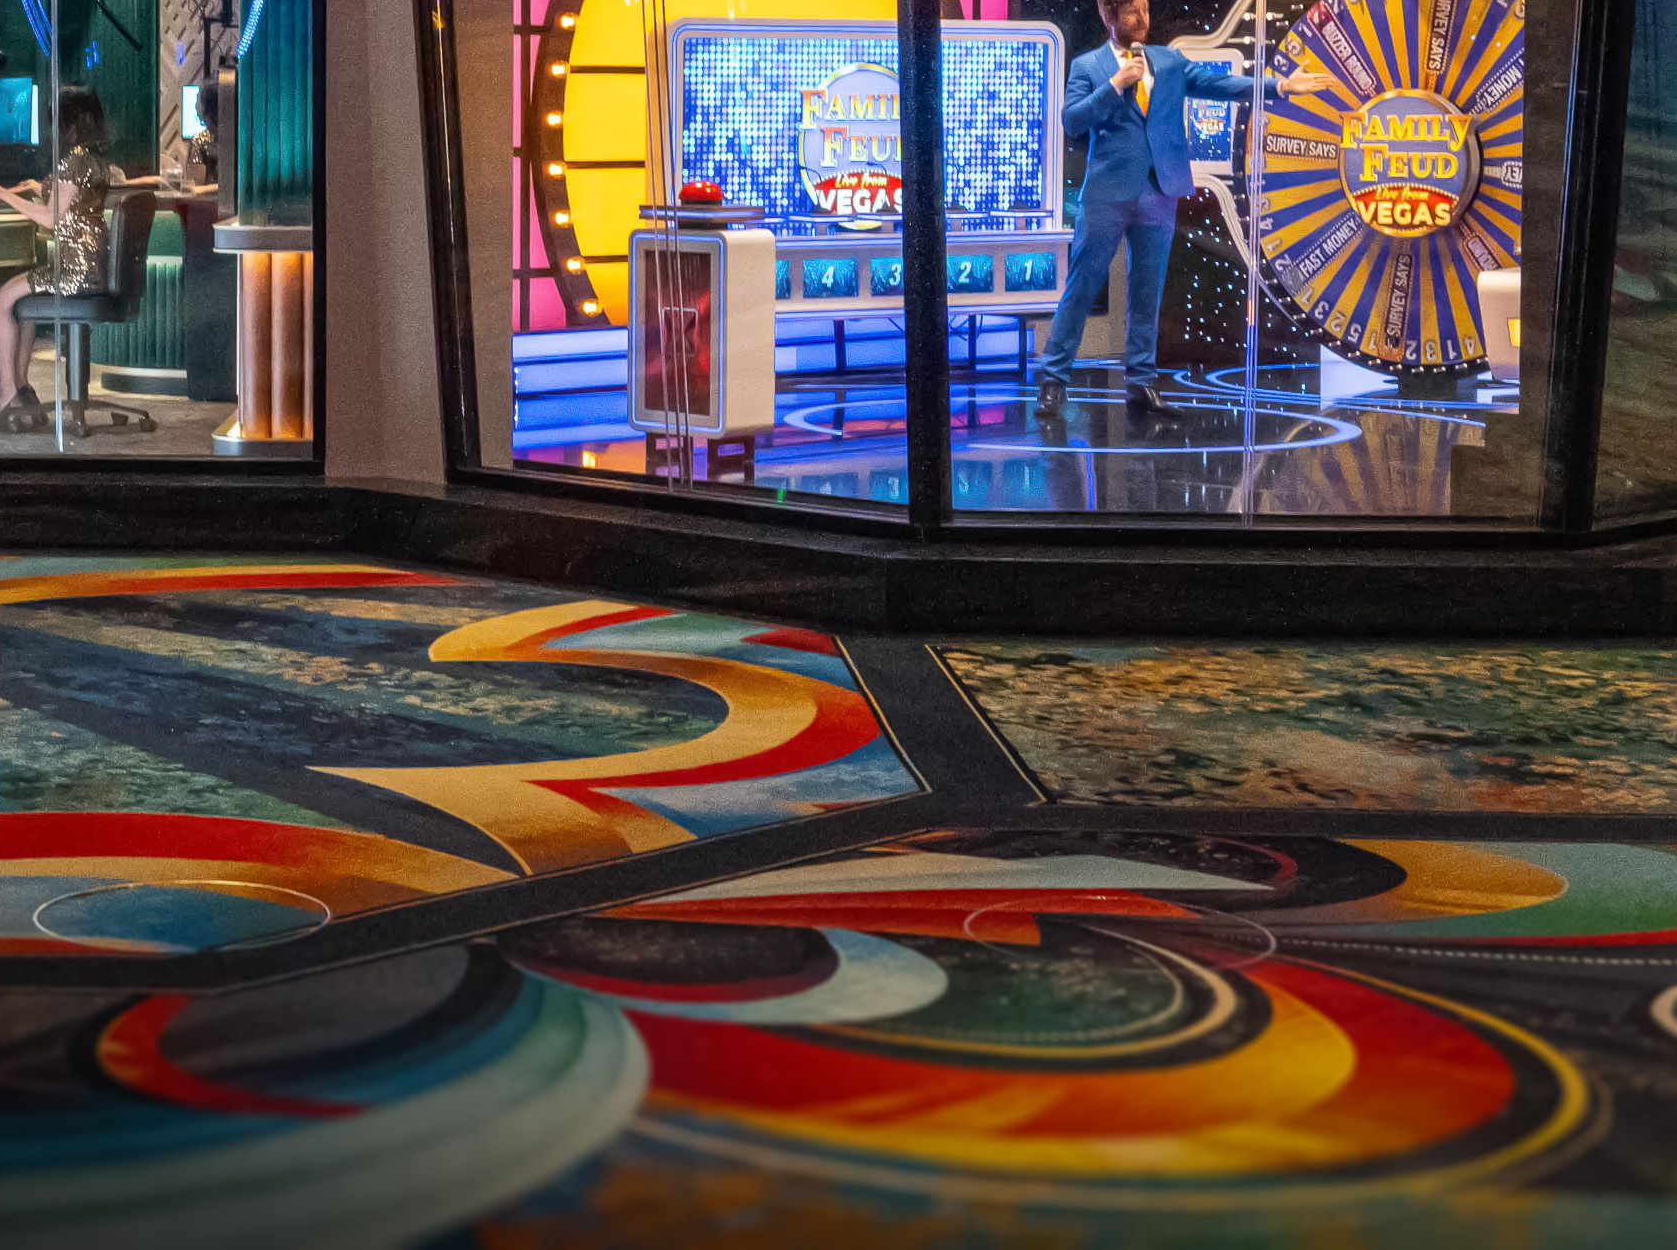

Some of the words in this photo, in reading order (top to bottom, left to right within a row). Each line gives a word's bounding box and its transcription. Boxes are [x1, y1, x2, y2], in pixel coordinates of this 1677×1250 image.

[1274, 54, 1290, 71] 3
[1428, 36, 1446, 70] SAYS
[1483, 65, 1523, 108] MONEY
[799, 88, 901, 131] FAMI
[1339, 111, 1474, 152] FAMILY
[1265, 134, 1306, 156] SURVEY
[1309, 141, 1337, 159] SAYS
[1359, 143, 1459, 183] FEUD
[1356, 200, 1452, 227] VEGAS
[1298, 251, 1324, 279] FAST
[1323, 217, 1356, 257] MONEY
[958, 261, 972, 283] 2
[1023, 259, 1034, 281] 1
[1274, 253, 1292, 272] 2
[1394, 254, 1411, 288] SAYS
[822, 266, 835, 288] 4
[889, 263, 902, 286] 3
[1314, 300, 1329, 320] 3
[1330, 310, 1346, 332] 2
[1386, 290, 1406, 337] SURVEY
[1347, 322, 1362, 344] 5
[1406, 340, 1418, 361] 2
[1425, 340, 1437, 361] 3
[1446, 339, 1458, 360] 1
[1463, 335, 1476, 356] 4
